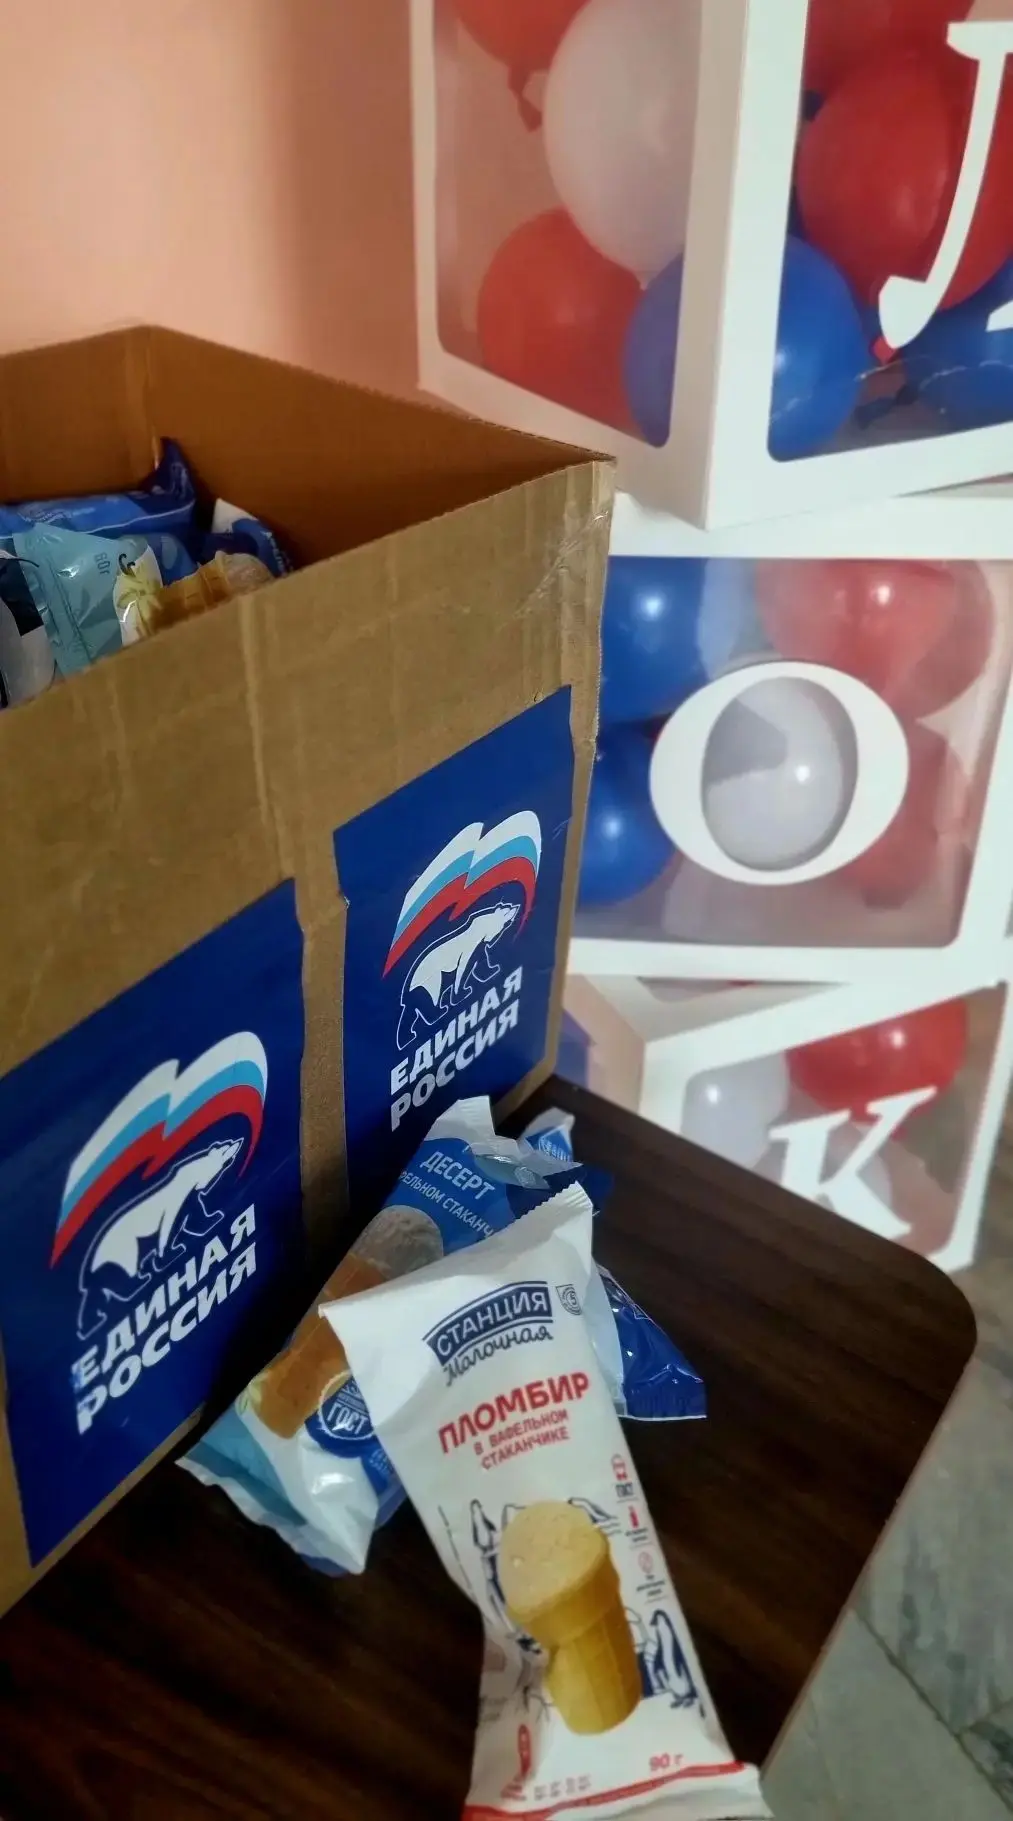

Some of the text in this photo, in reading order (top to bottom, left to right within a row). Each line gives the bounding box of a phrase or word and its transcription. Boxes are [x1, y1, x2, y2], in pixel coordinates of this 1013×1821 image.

[649, 661, 909, 886] О
[390, 965, 523, 1096] ЕДИНАЯ
[390, 999, 520, 1133] РОССИЯ
[418, 1151, 496, 1200] ДЕСЕРТ
[768, 1085, 938, 1240] К
[71, 1203, 256, 1391] ЕДИНАЯ
[436, 1291, 549, 1357] СТАНЦИЯ
[75, 1241, 257, 1436] РОССИЯ
[443, 1325, 554, 1387] Молочная
[327, 1402, 370, 1435] ГОСТ
[438, 1371, 590, 1454] ПЛОМБИР
[481, 1426, 571, 1470] СТАКАНЧИКЕ
[488, 1408, 569, 1449] ВАФЕЛЬНОМ
[648, 1752, 671, 1772] 90
